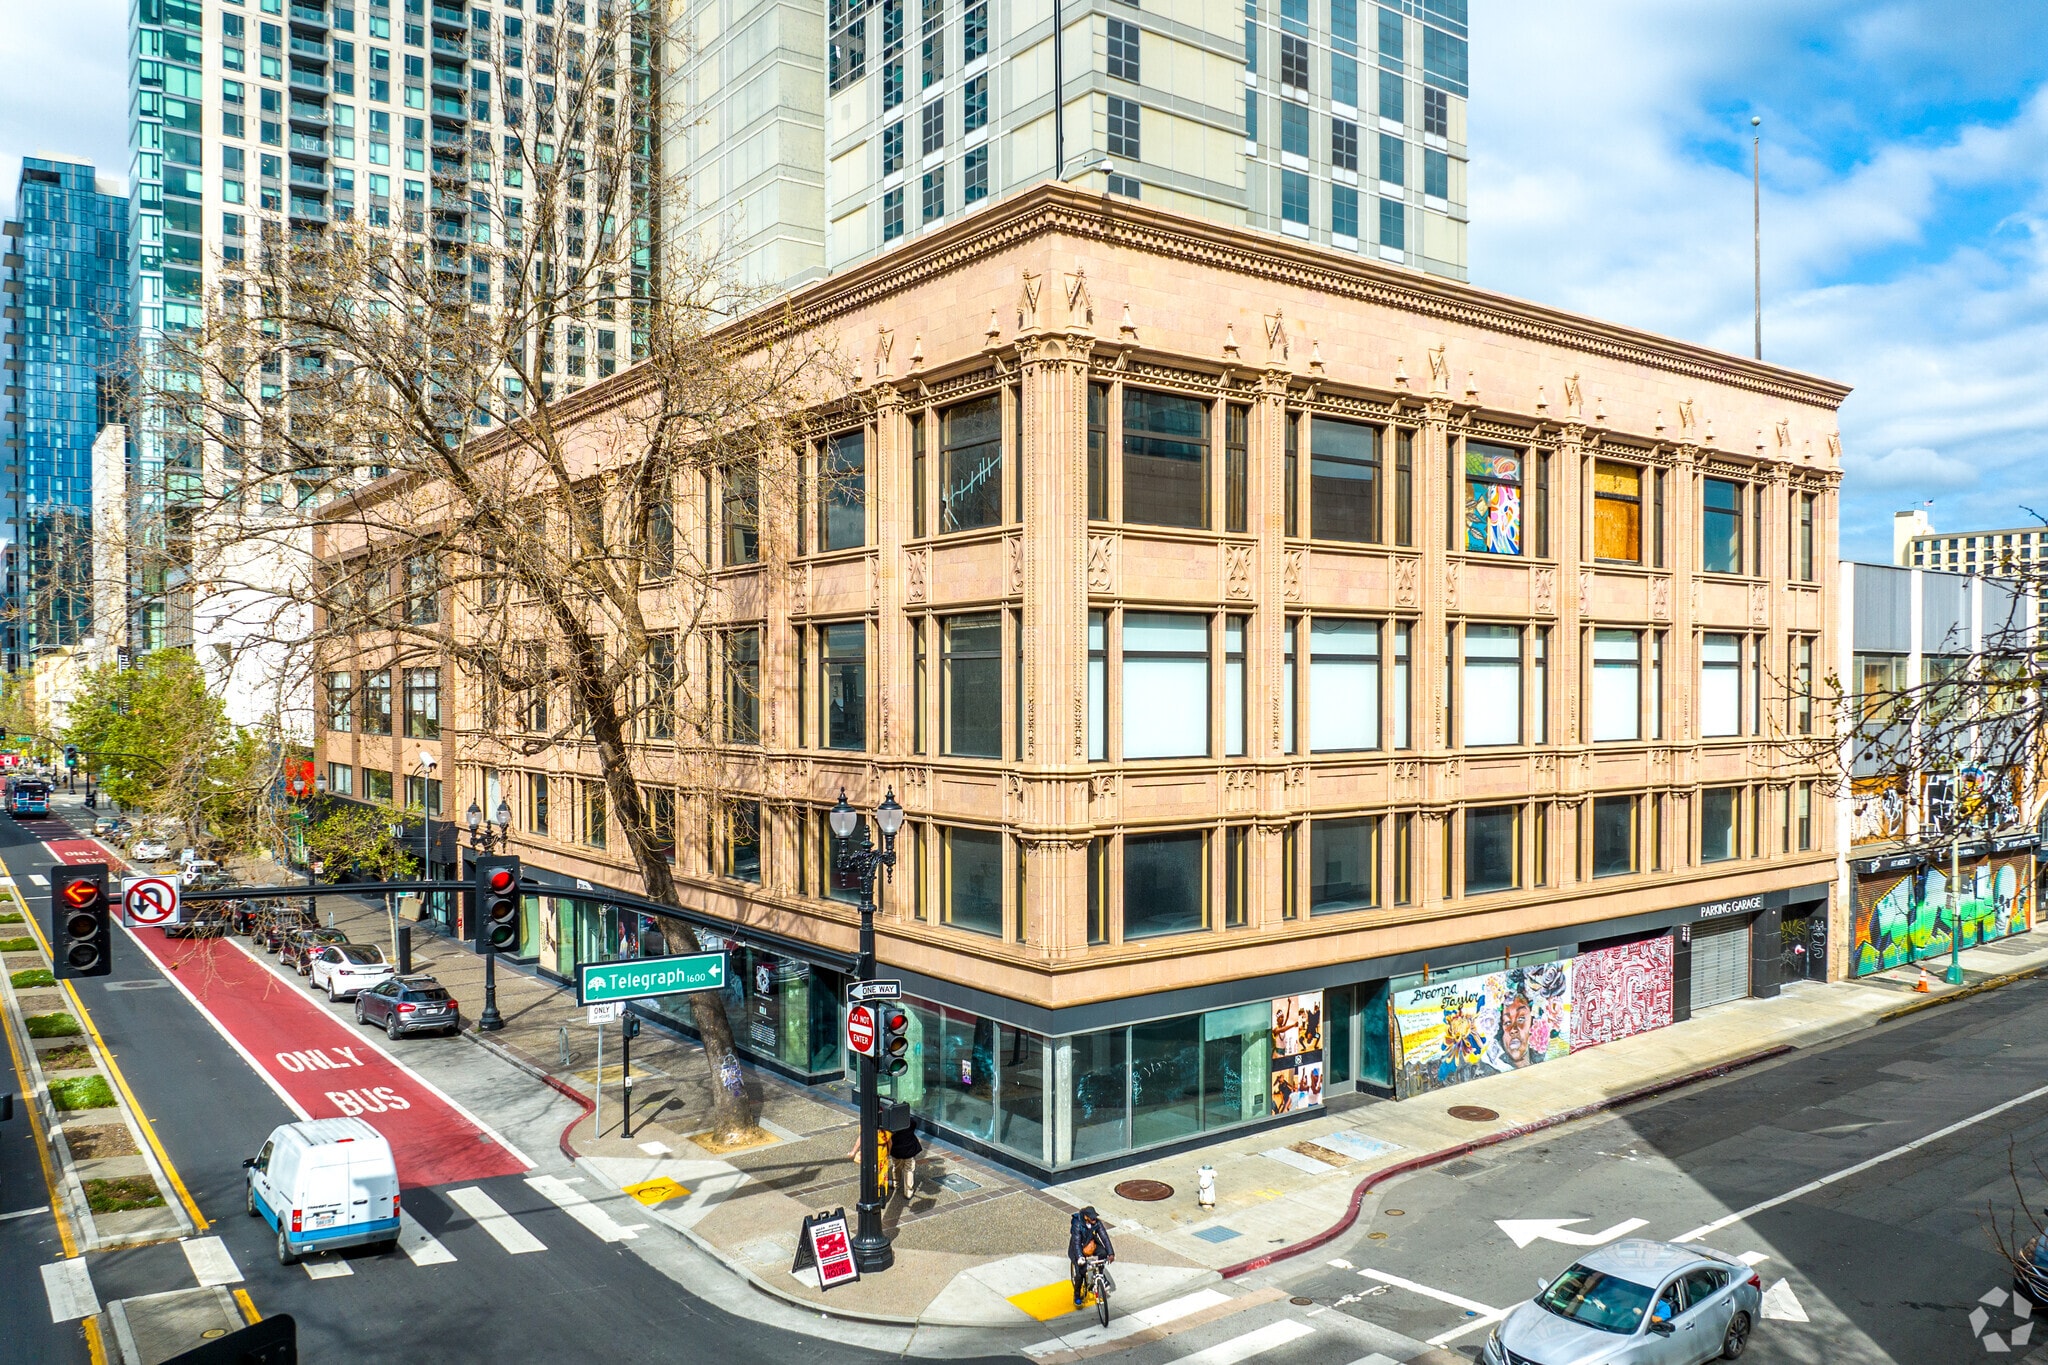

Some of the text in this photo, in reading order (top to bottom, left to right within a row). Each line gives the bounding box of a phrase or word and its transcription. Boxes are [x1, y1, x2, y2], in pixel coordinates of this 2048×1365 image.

[1700, 897, 1761, 917] PARKING GARAGE
[608, 968, 706, 990] Telegraph 1600
[862, 985, 894, 994] ONE WAY
[1410, 984, 1457, 1005] Breonna
[1441, 990, 1479, 1009] Taylor
[593, 1006, 610, 1014] ONLY
[851, 1013, 870, 1025] DO NOT
[853, 1033, 869, 1045] ENTER
[275, 1046, 364, 1073] ONLY
[324, 1086, 411, 1117] BUS
[824, 1261, 844, 1271] HAPPY
[825, 1267, 846, 1279] HOUR
